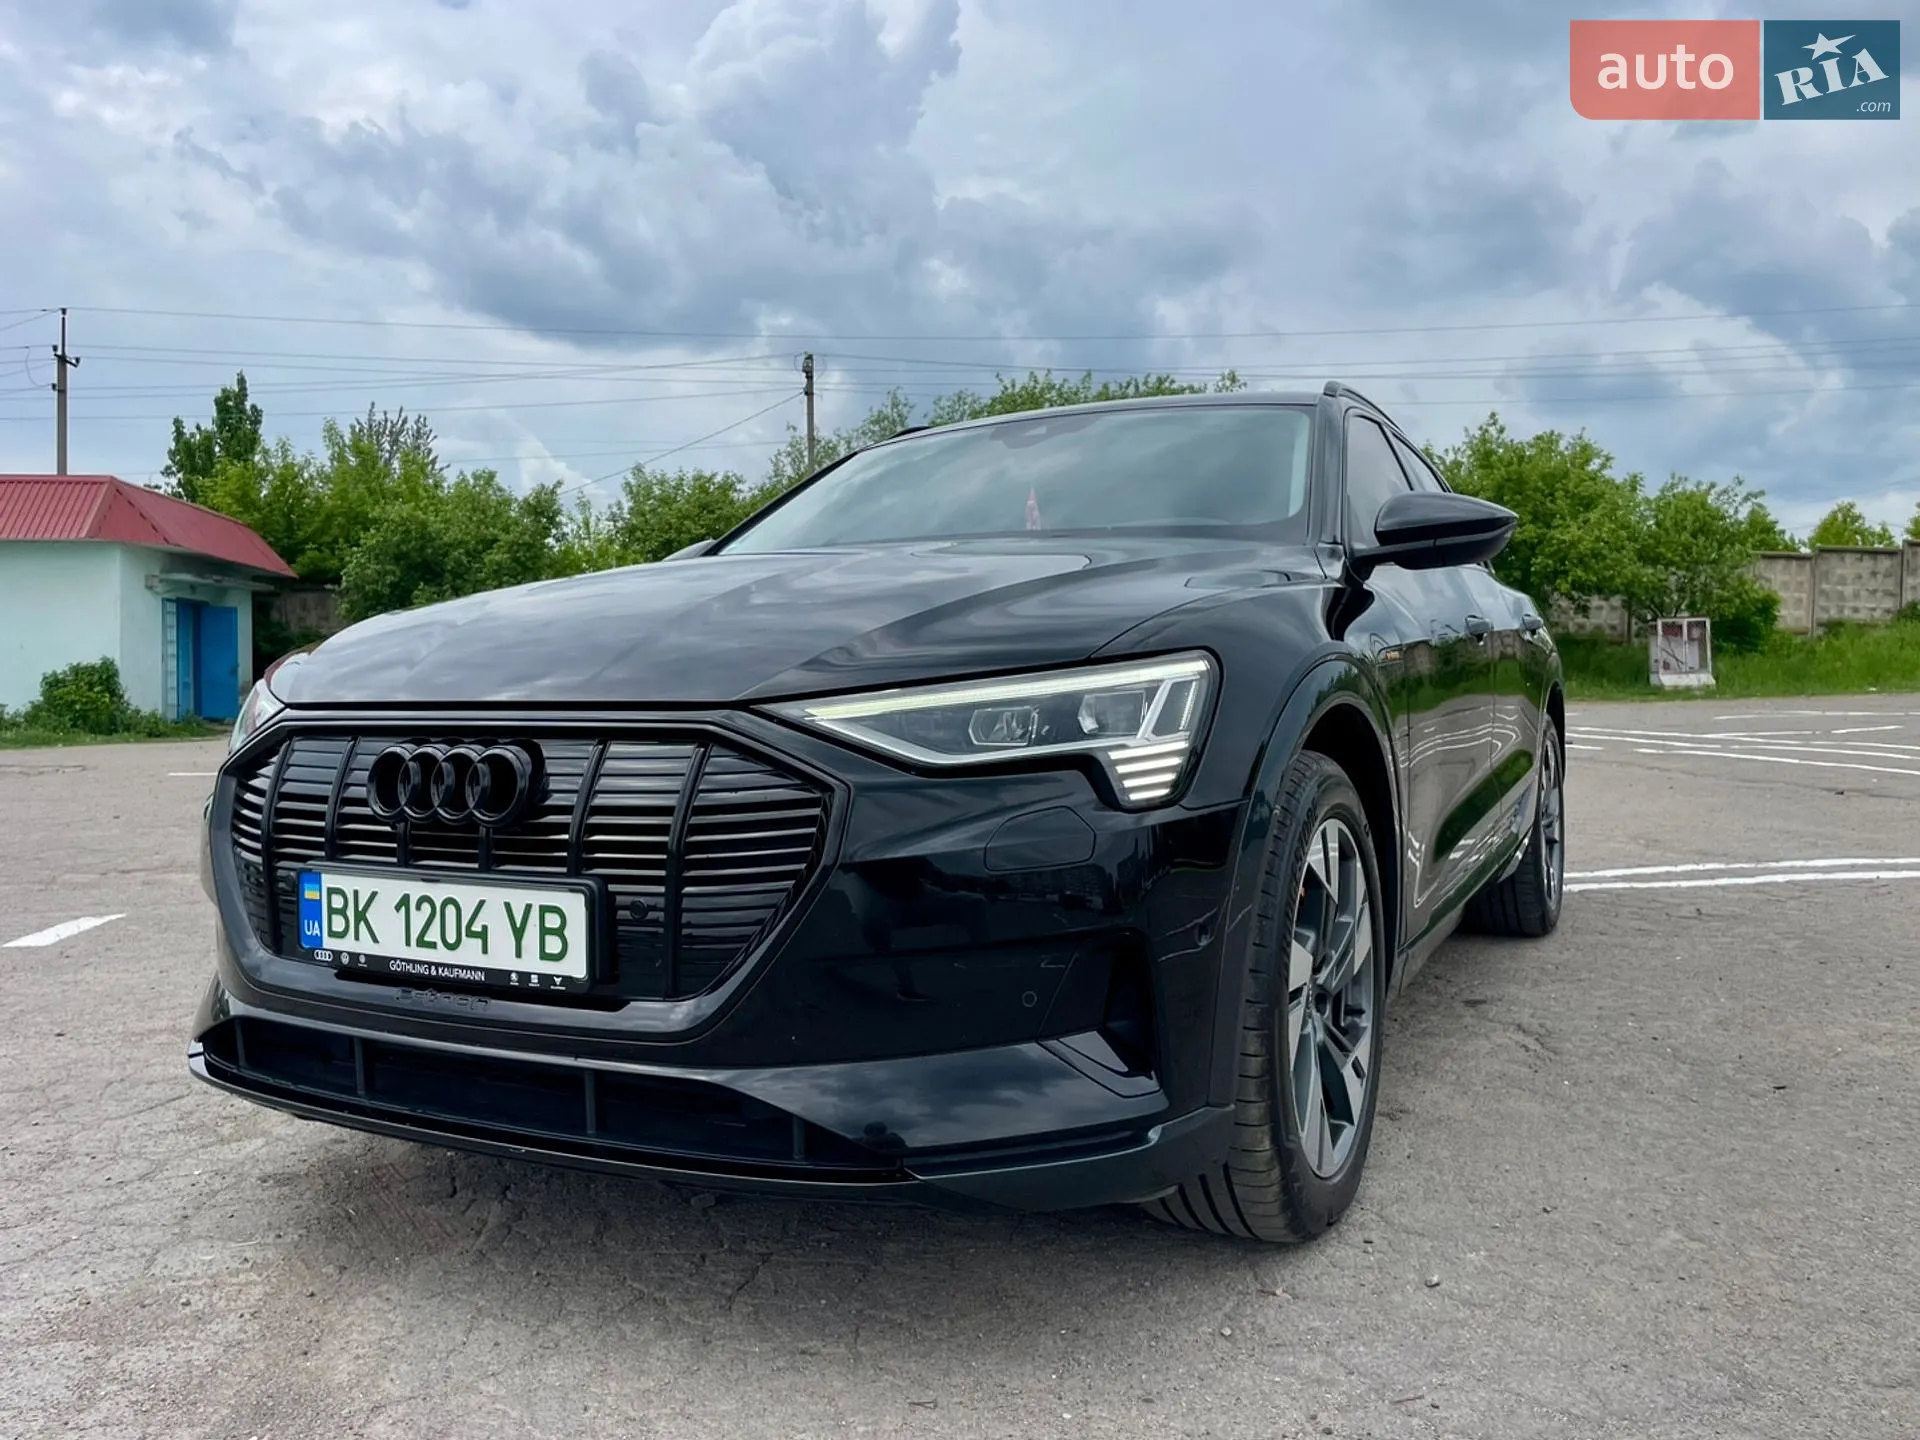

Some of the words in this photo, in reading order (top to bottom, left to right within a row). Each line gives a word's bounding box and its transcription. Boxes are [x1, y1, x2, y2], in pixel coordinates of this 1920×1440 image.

[304, 919, 321, 937] UA
[326, 886, 380, 945] BK
[394, 893, 488, 955] 1204
[503, 901, 569, 962] YB
[430, 965, 437, 976] &
[438, 966, 486, 982] KAUFMANN
